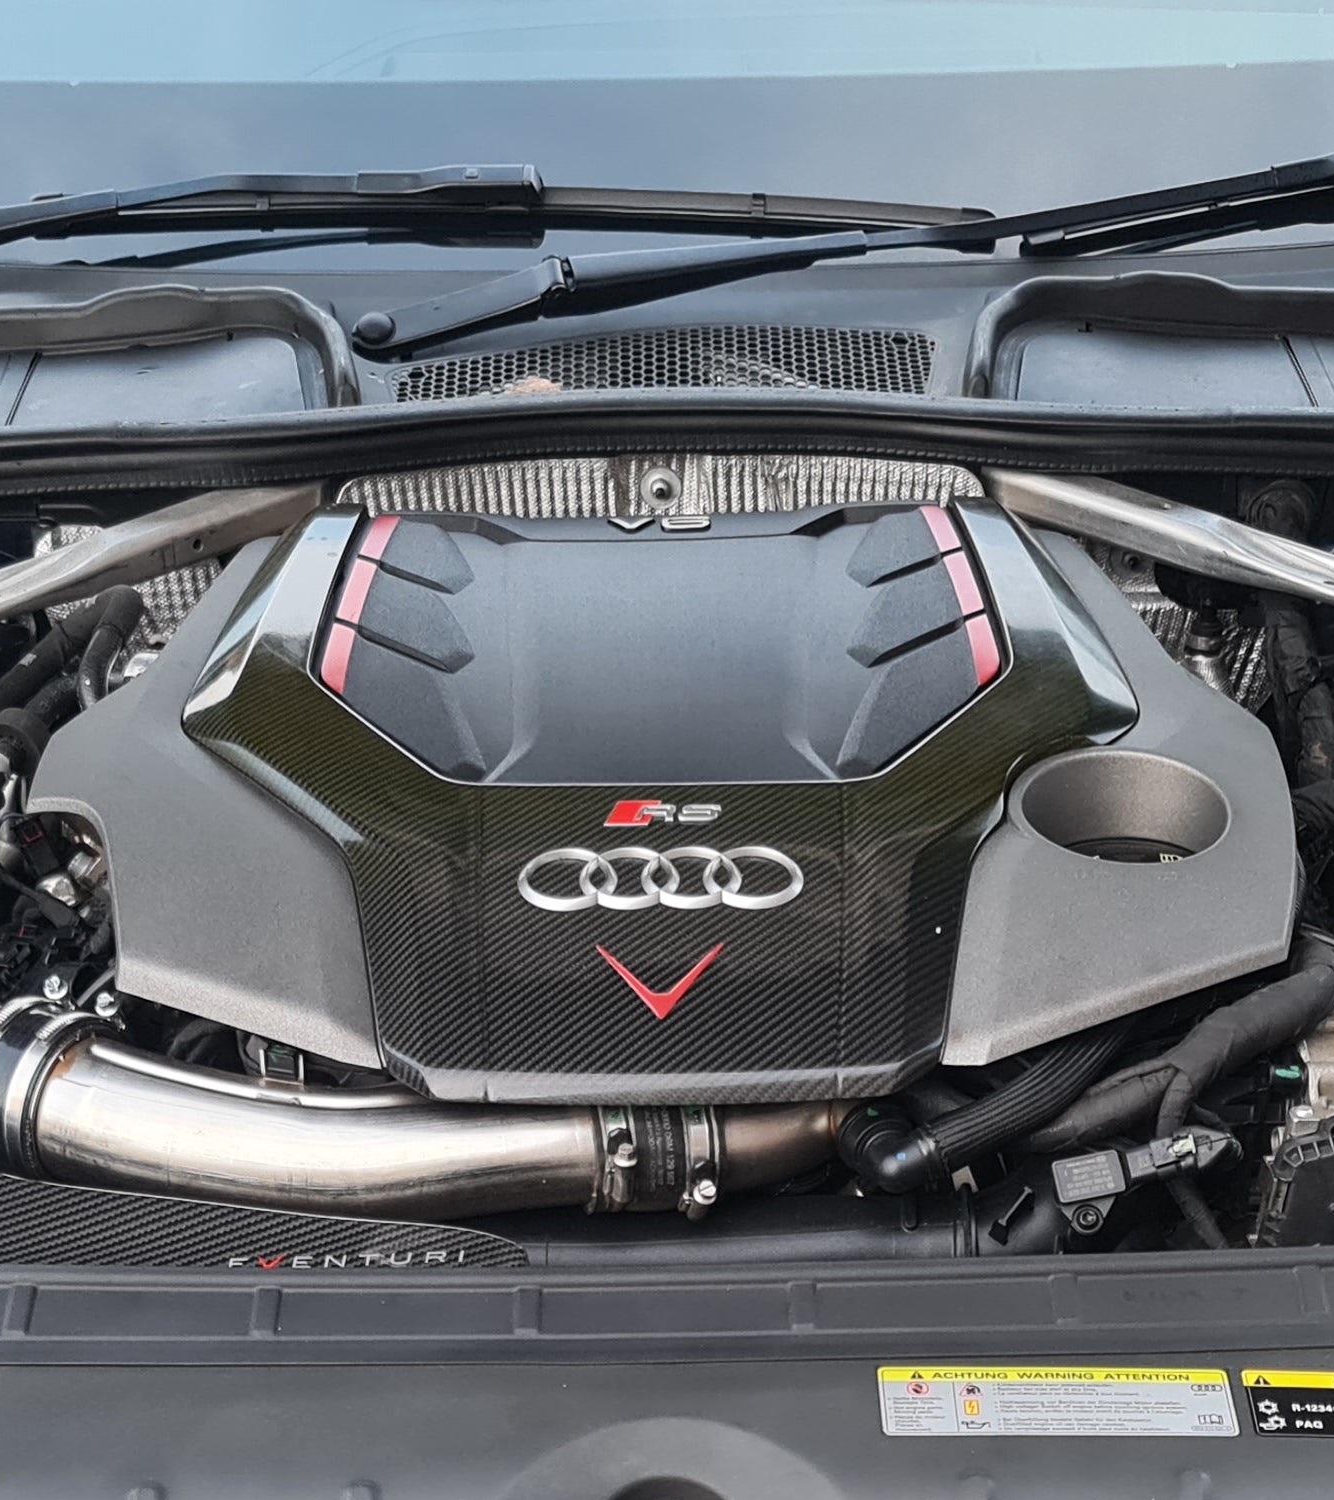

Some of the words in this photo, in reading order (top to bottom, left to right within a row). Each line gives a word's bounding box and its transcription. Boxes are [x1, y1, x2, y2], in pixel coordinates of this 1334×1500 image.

[228, 1250, 465, 1270] EVENTURI
[932, 1372, 1008, 1380] ACHTUNG
[1017, 1372, 1094, 1380] WARNING
[1104, 1373, 1190, 1381] ATTENTION
[1295, 1420, 1324, 1430] PAG
